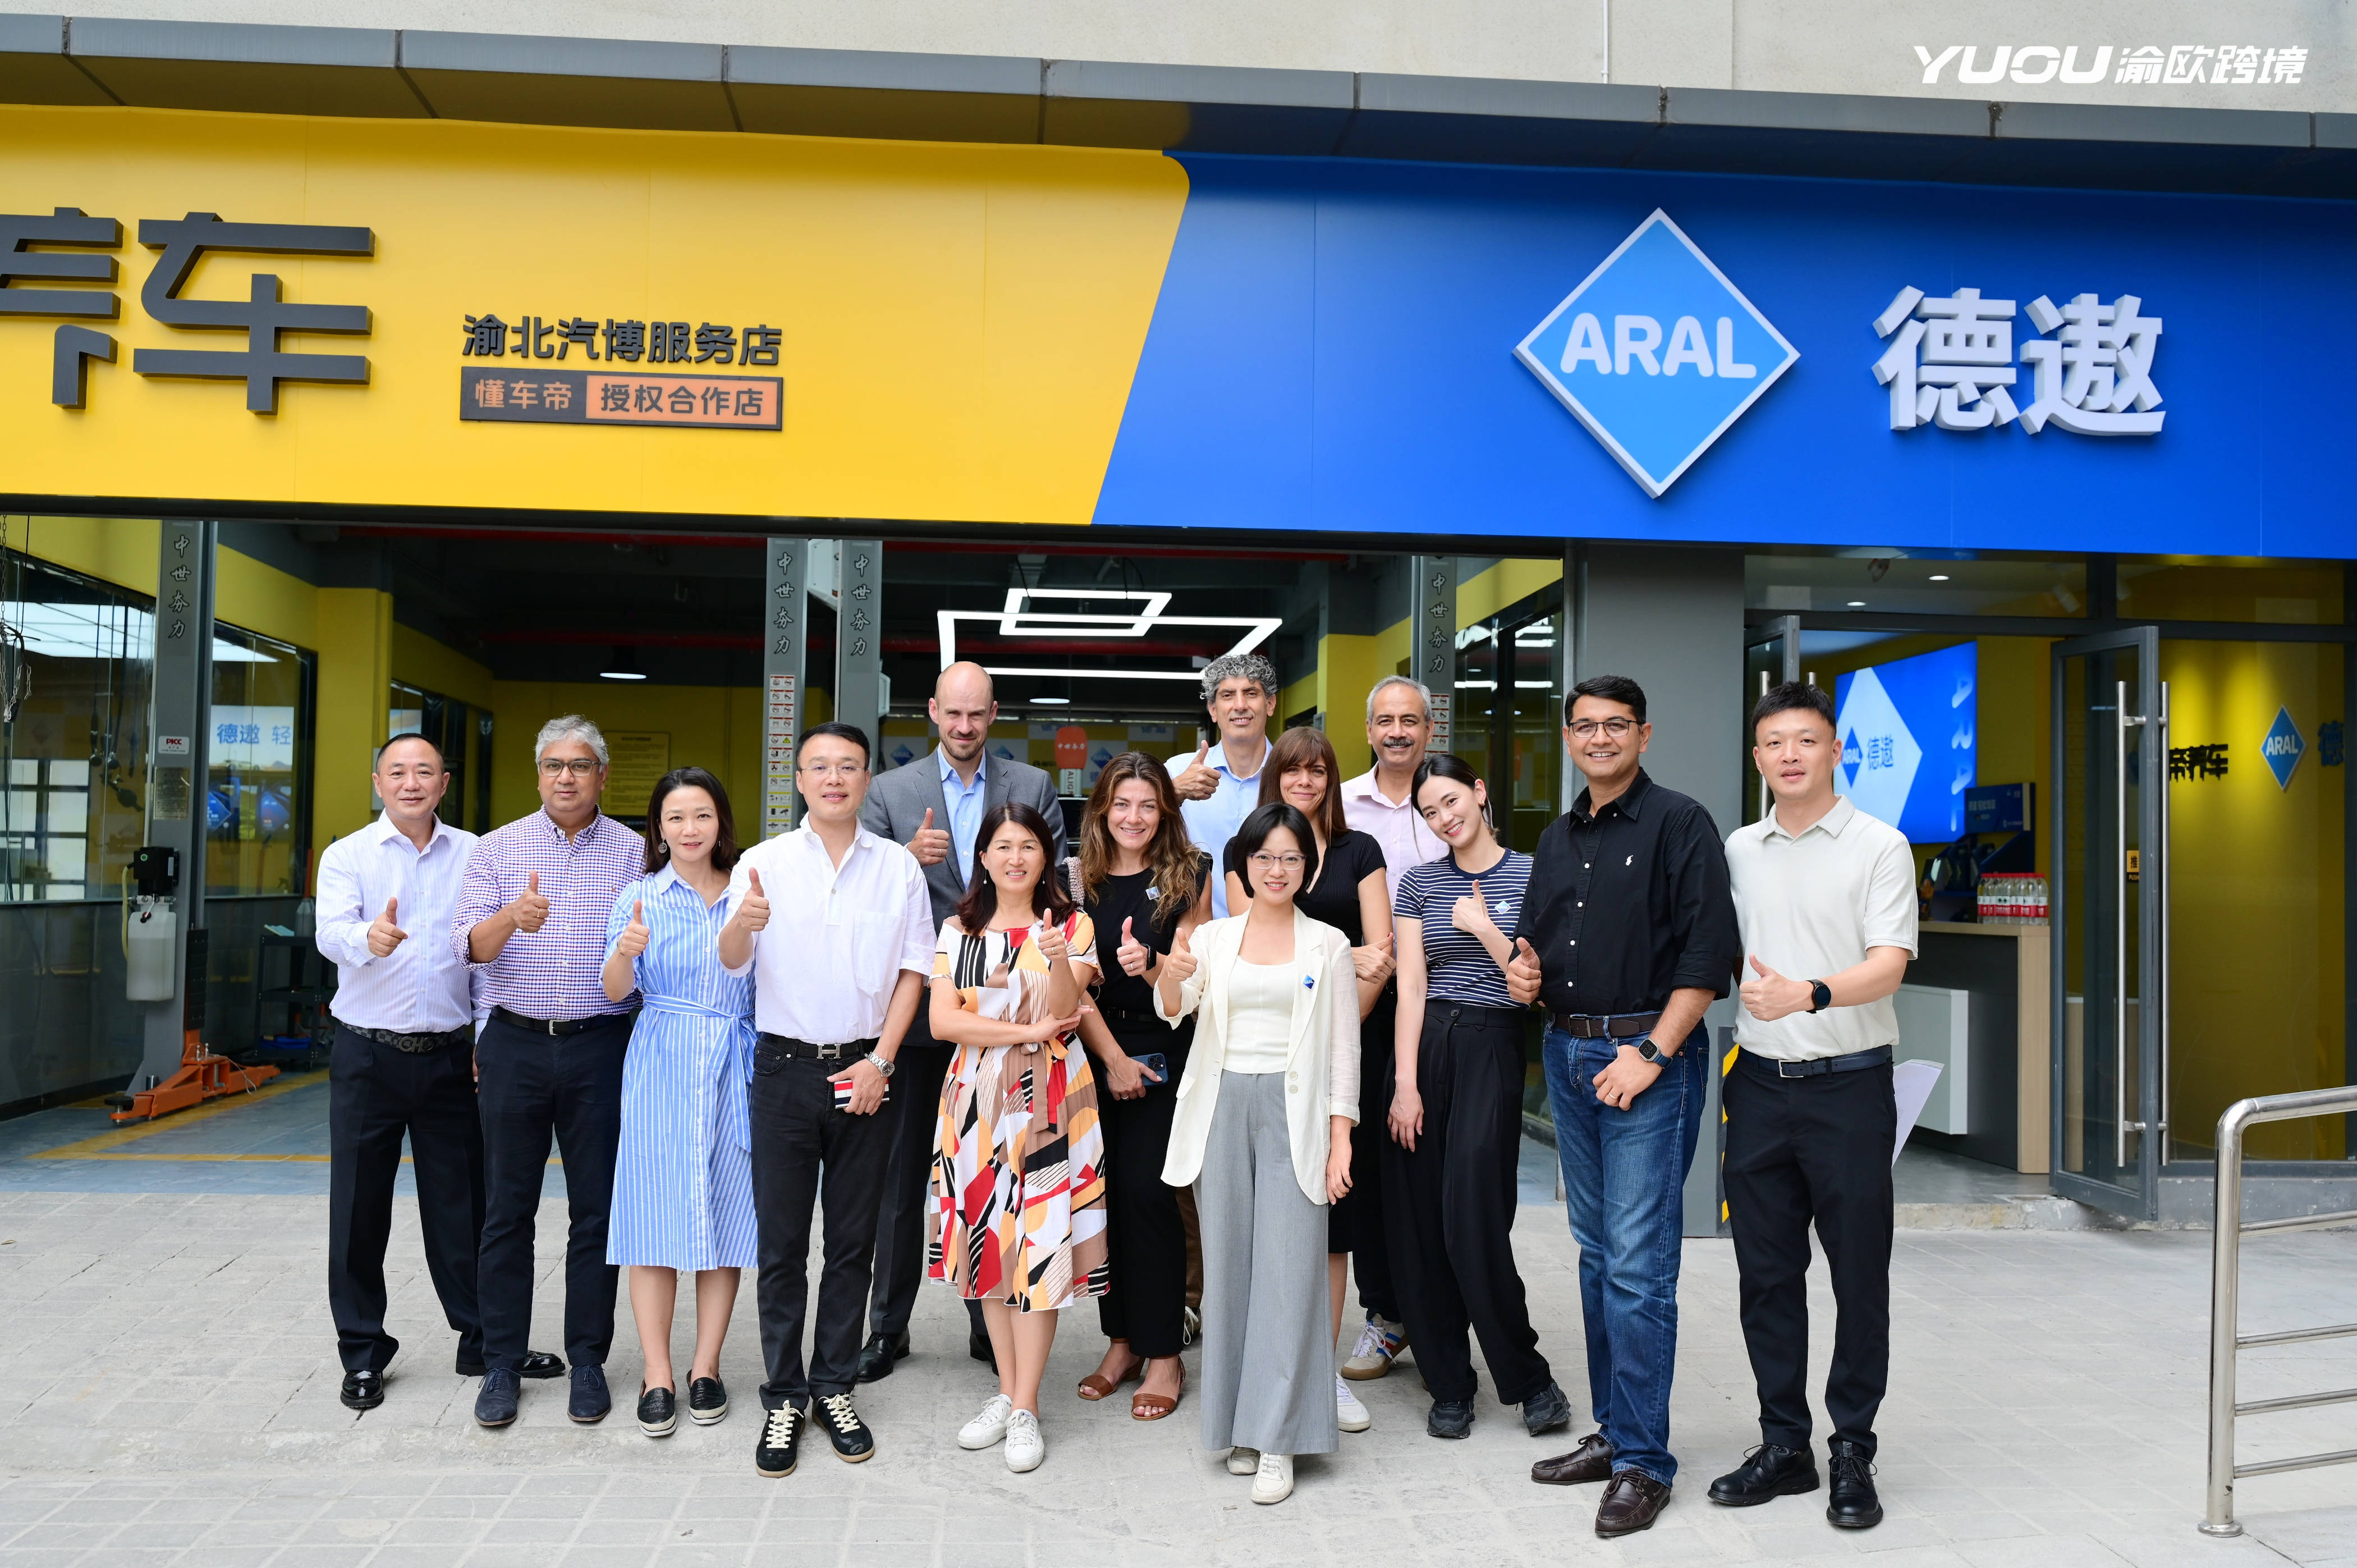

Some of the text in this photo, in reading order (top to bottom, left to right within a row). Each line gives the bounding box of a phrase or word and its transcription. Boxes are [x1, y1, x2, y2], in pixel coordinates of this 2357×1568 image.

[462, 314, 782, 365] 渝北汽博服务店
[1560, 312, 1757, 379] ARAL
[1871, 285, 2166, 436] 德遨
[475, 378, 763, 416] 懂车帝 授权合作店
[168, 534, 191, 639] 中世夯力
[774, 552, 795, 654] 中世夯力
[850, 554, 872, 656] 中世夯力
[1429, 572, 1449, 673] 中世夯力
[217, 723, 291, 745] 德遨 轻
[1867, 734, 1894, 771] 德遨
[2266, 735, 2299, 757] ARAL
